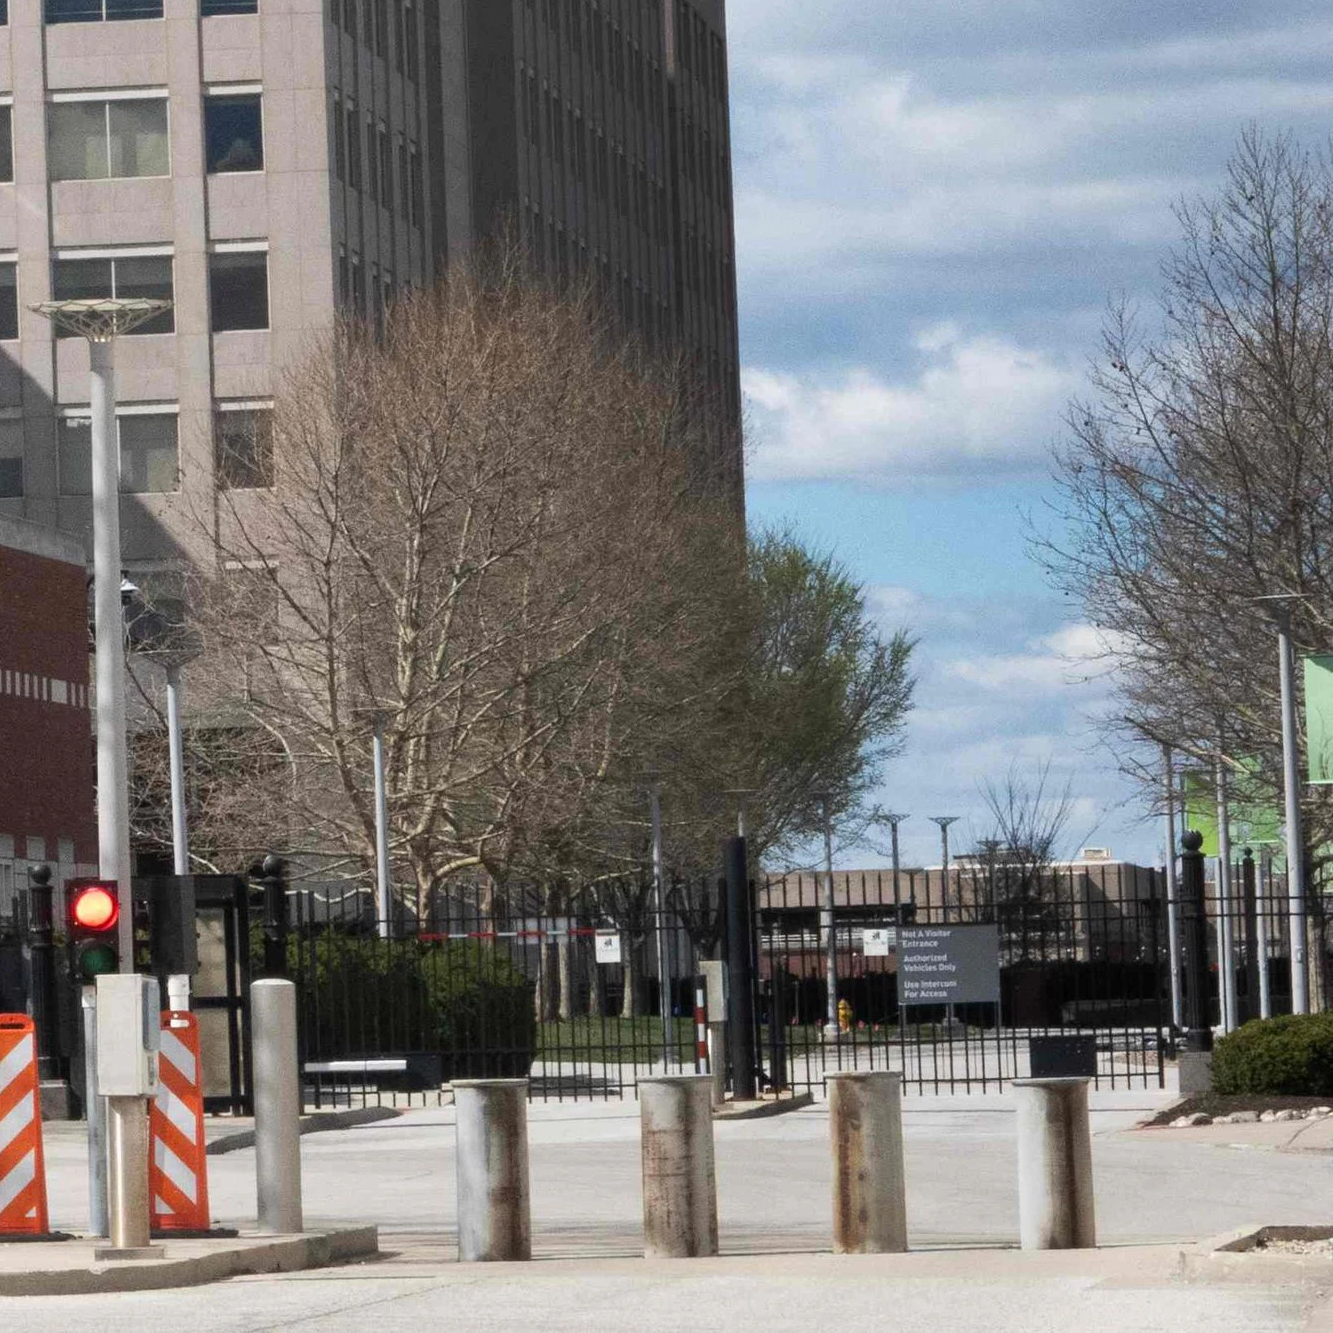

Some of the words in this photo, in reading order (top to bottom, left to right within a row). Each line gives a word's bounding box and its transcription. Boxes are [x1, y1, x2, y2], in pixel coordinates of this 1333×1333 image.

[901, 930, 916, 938] Not
[918, 930, 924, 938] A
[925, 929, 951, 937] Visitor
[902, 939, 939, 947] Entrance
[904, 953, 947, 962] Authorized
[904, 964, 937, 972] Vehicles
[938, 963, 956, 972] Only
[904, 981, 919, 989] Use
[921, 980, 957, 988] Intercom
[904, 990, 918, 998] For
